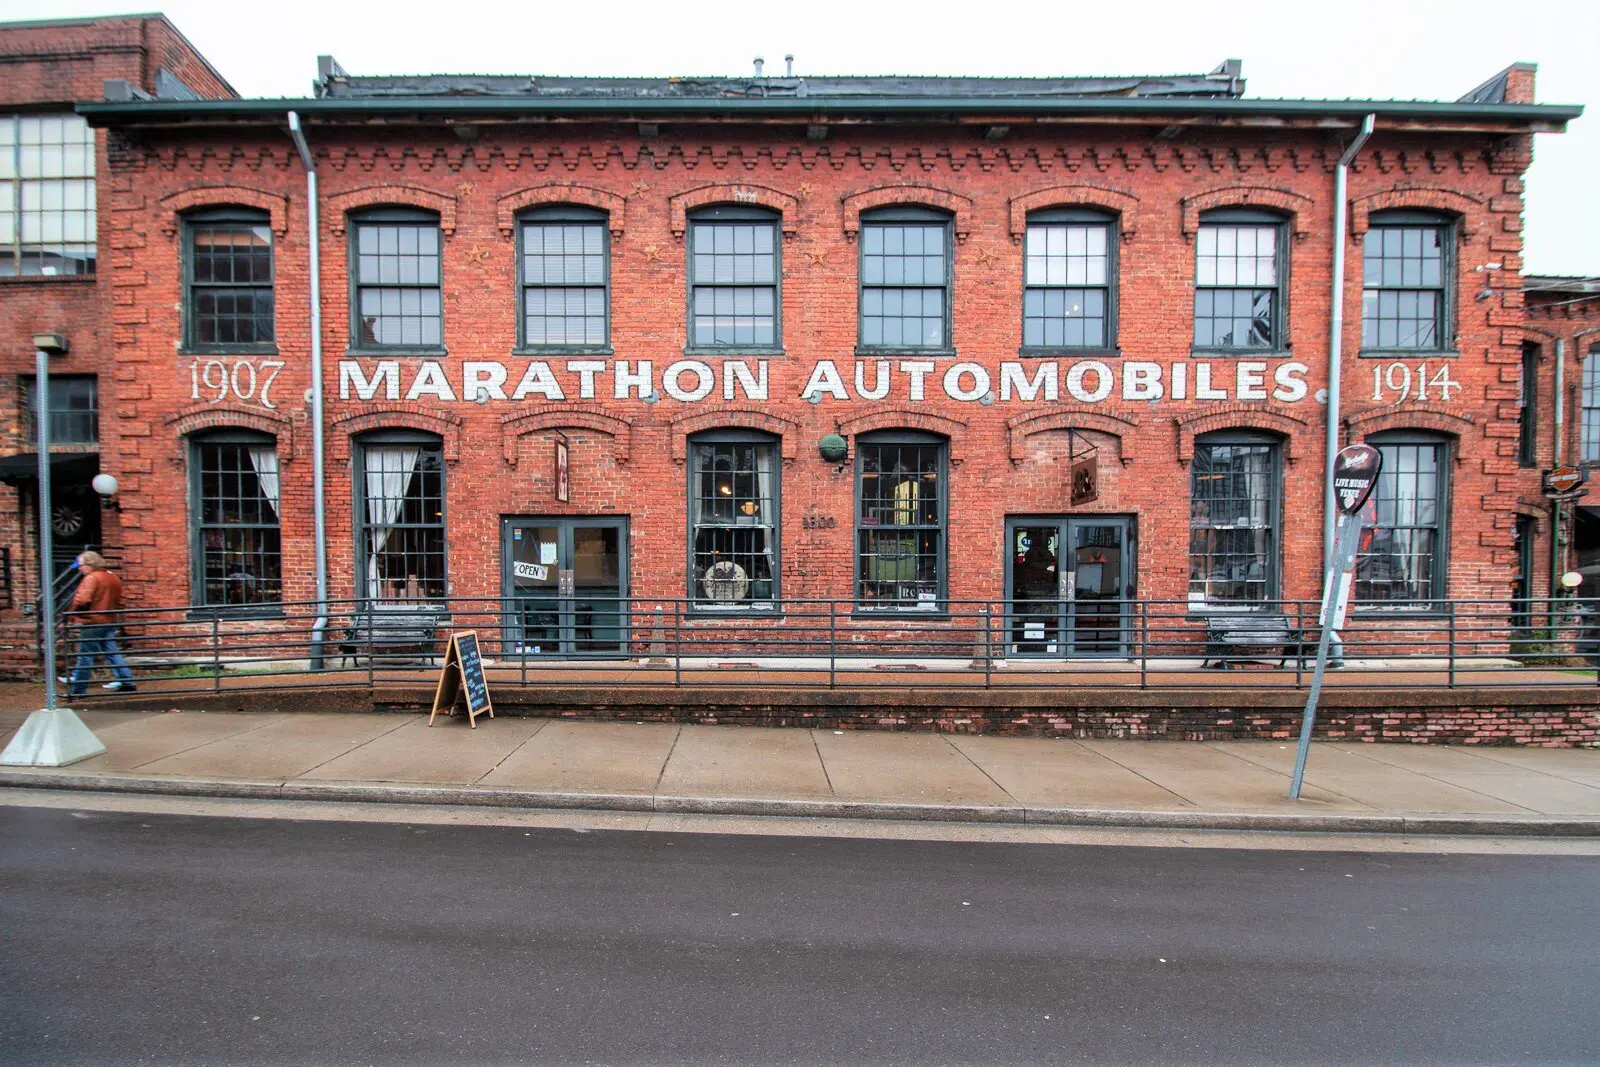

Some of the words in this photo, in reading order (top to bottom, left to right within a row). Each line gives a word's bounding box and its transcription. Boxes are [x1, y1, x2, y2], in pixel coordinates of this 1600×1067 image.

[188, 360, 285, 409] 1907
[337, 359, 770, 403] MARATHON
[800, 359, 1309, 403] AUTOMOBILES
[1371, 361, 1463, 405] 1914
[1335, 478, 1348, 487] LIVE
[519, 564, 540, 577] OPEN
